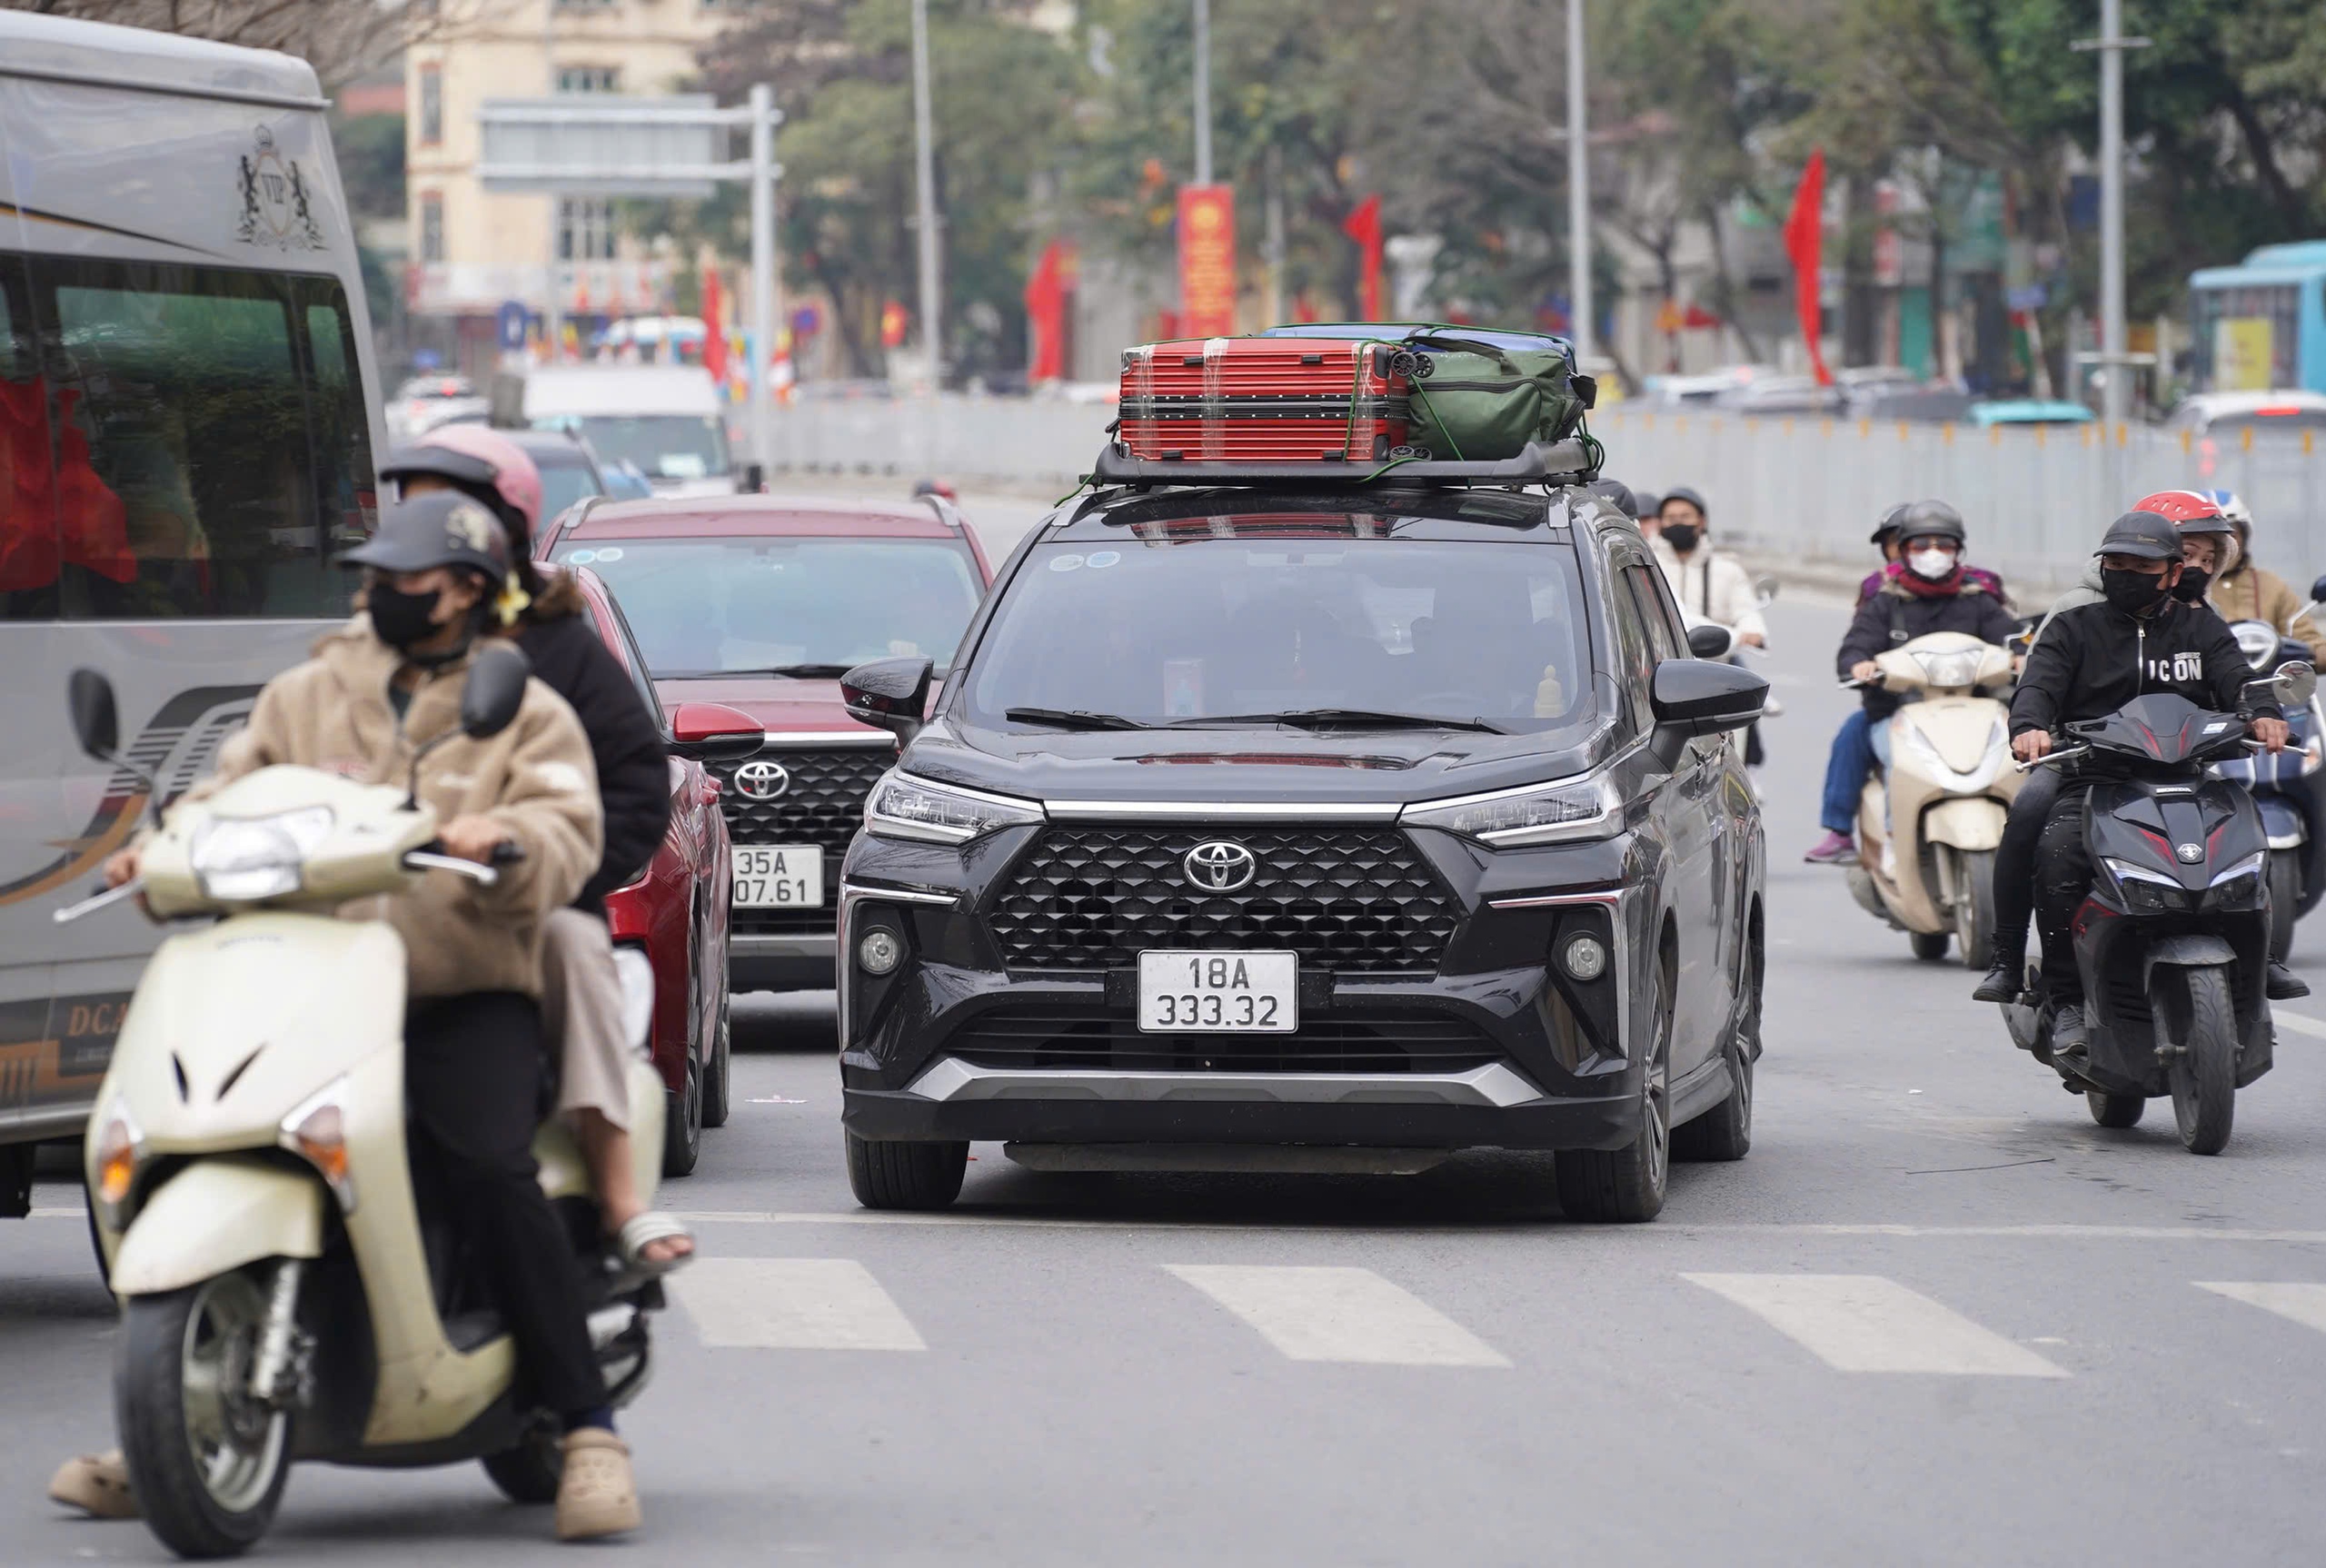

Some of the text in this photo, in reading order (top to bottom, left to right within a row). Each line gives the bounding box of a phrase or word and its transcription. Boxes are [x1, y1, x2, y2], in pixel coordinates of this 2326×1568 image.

[2149, 660, 2202, 682] ICON
[738, 851, 788, 875] 35A
[1188, 958, 1250, 989] 18A
[1157, 994, 1278, 1027] 333.32
